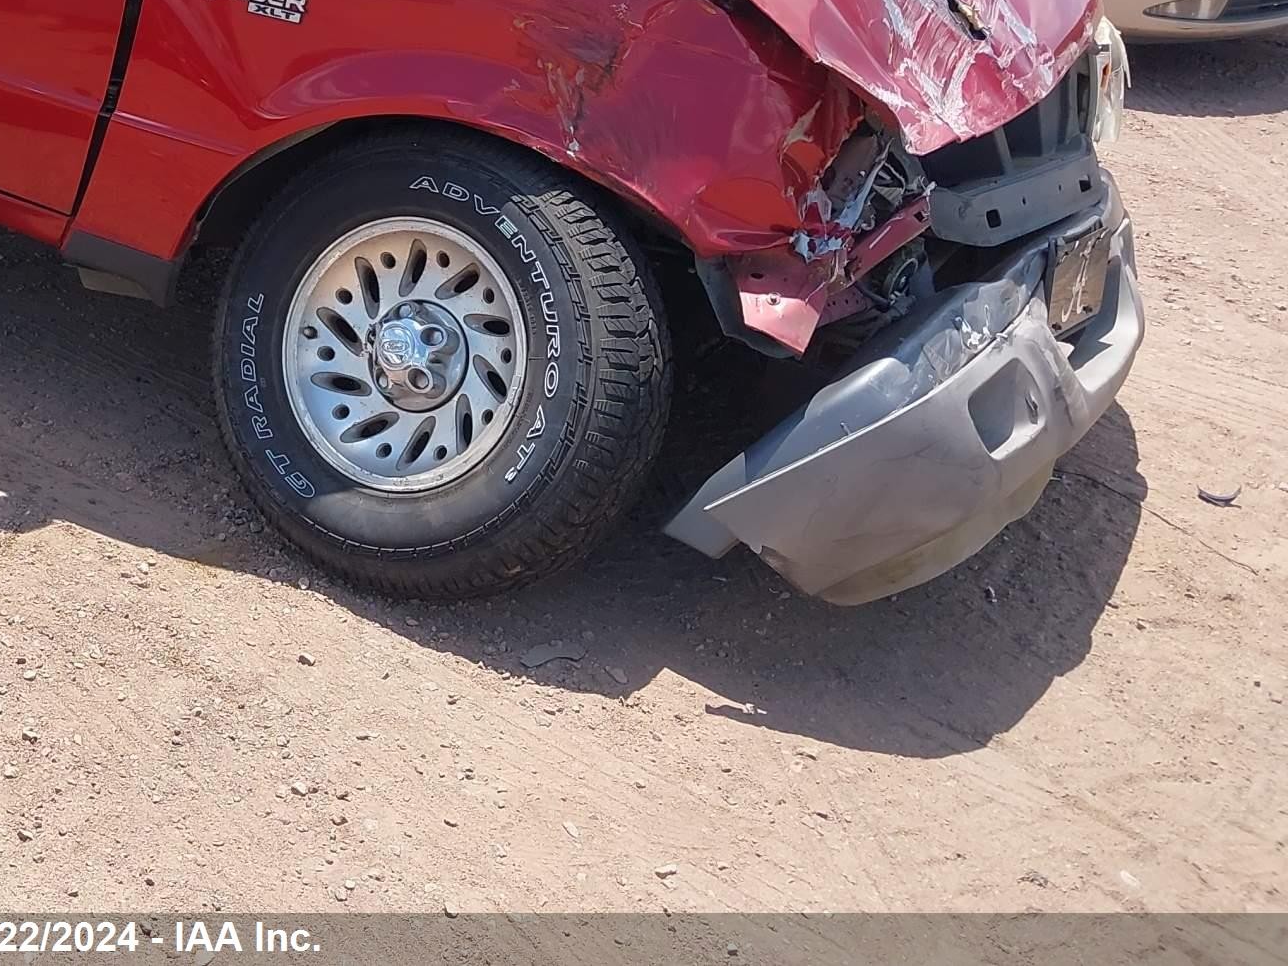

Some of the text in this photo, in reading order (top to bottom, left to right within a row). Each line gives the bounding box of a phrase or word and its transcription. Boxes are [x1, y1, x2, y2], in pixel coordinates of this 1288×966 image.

[253, 4, 296, 21] XLT
[409, 176, 561, 398] ADVENTURO
[241, 293, 316, 498] GT RADIAL
